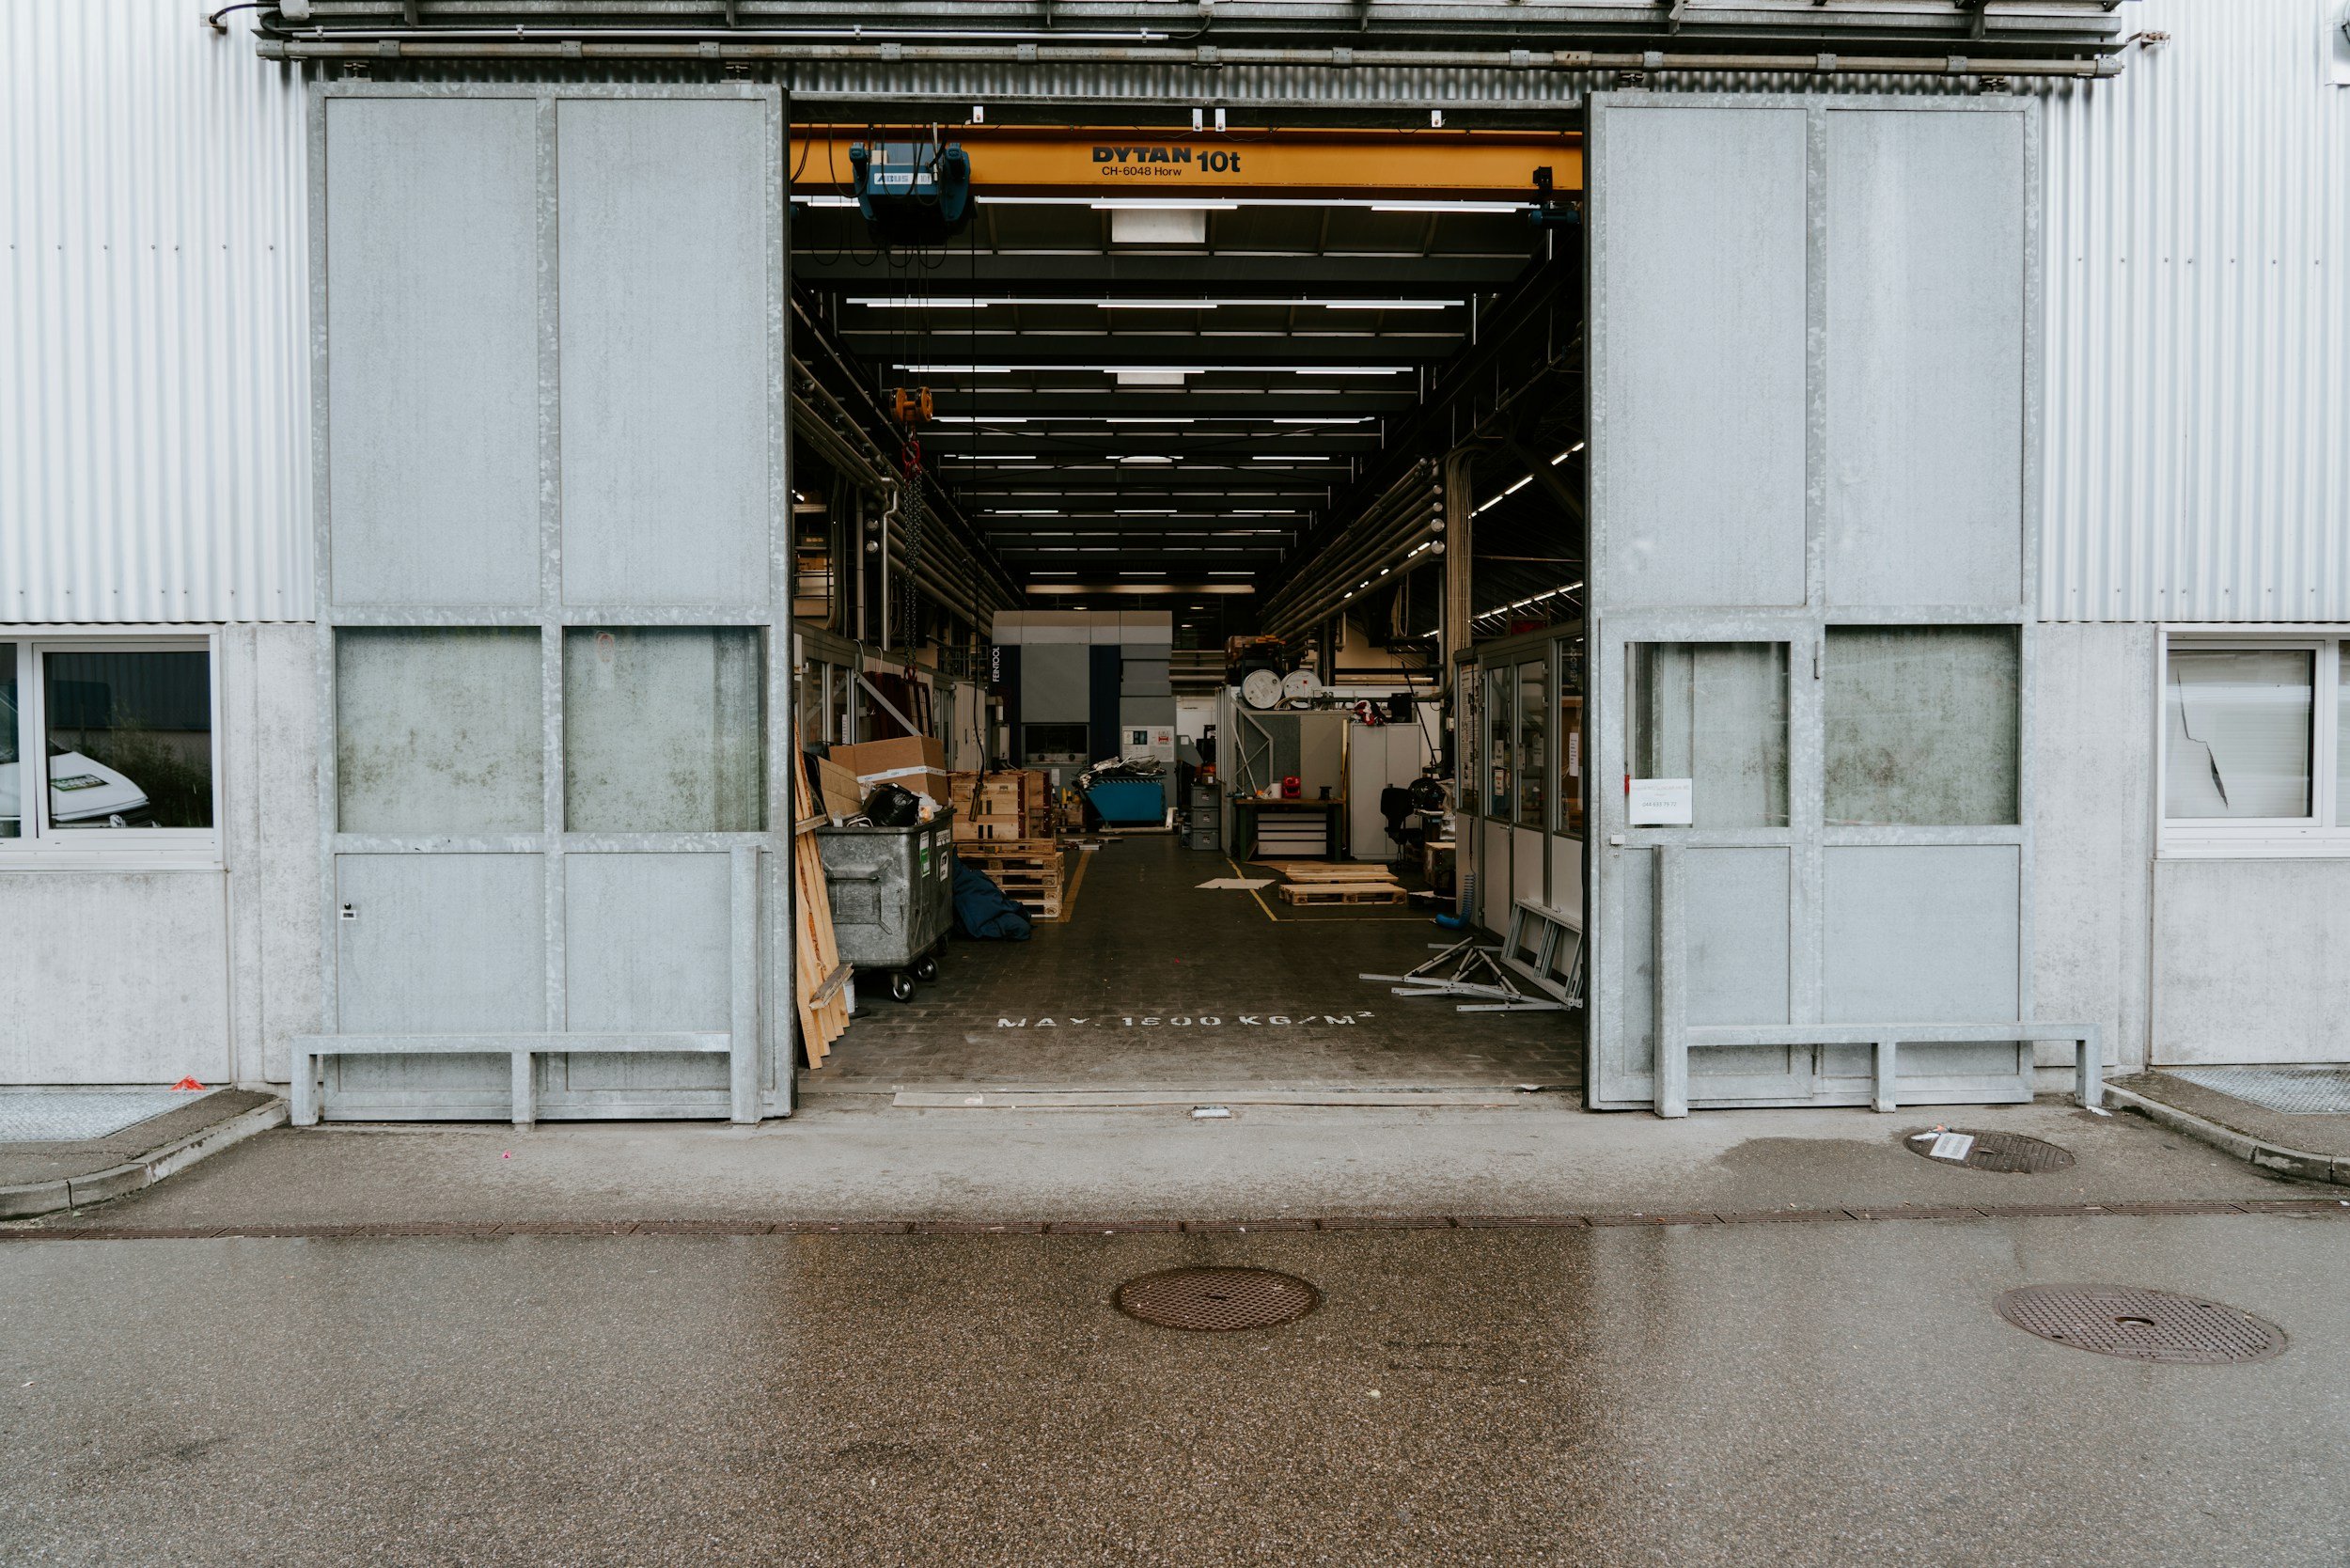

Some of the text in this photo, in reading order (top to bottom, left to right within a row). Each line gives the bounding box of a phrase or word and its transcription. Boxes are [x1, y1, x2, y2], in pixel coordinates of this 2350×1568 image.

[1093, 147, 1240, 172] DYTAN 10t
[1102, 166, 1182, 177] CH-6048 Horw
[992, 646, 1000, 682] FEINTOOL
